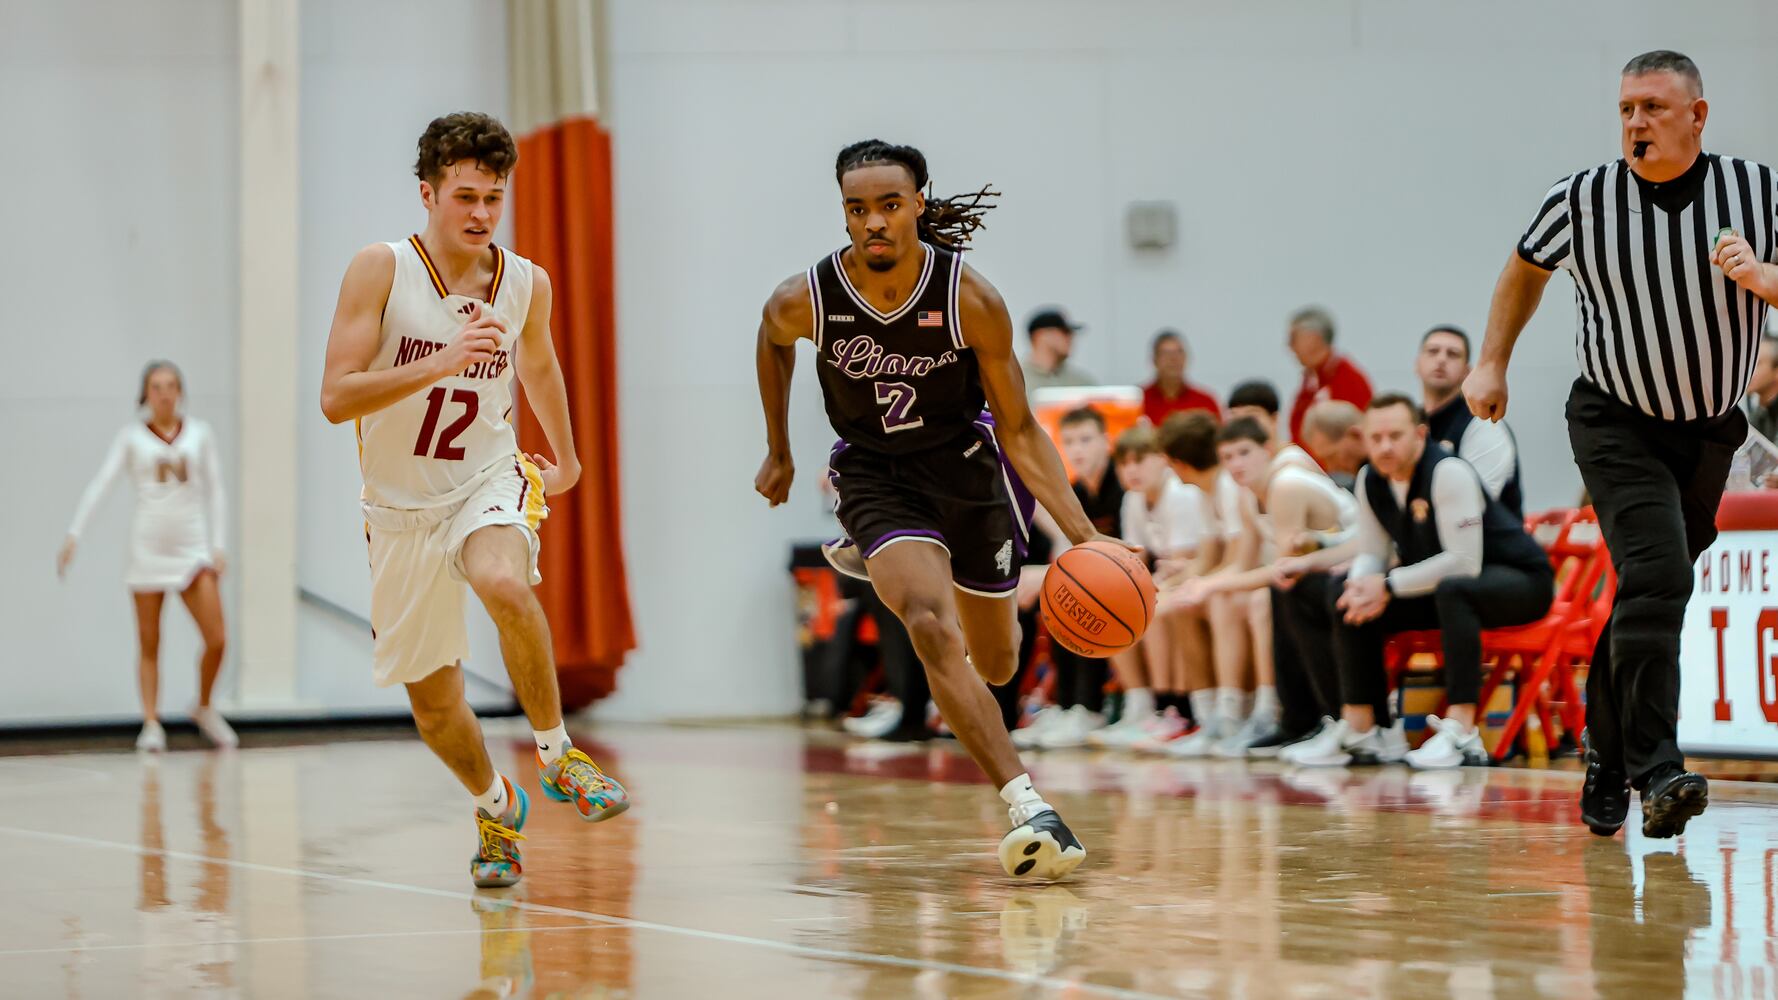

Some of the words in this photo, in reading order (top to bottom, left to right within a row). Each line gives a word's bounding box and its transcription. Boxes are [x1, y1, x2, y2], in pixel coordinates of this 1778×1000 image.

[413, 386, 479, 461] 12
[874, 381, 924, 434] 2
[155, 456, 188, 483] N
[1701, 549, 1770, 593] HOME
[1053, 583, 1108, 636] OHSAA
[1678, 607, 1778, 727] IG
